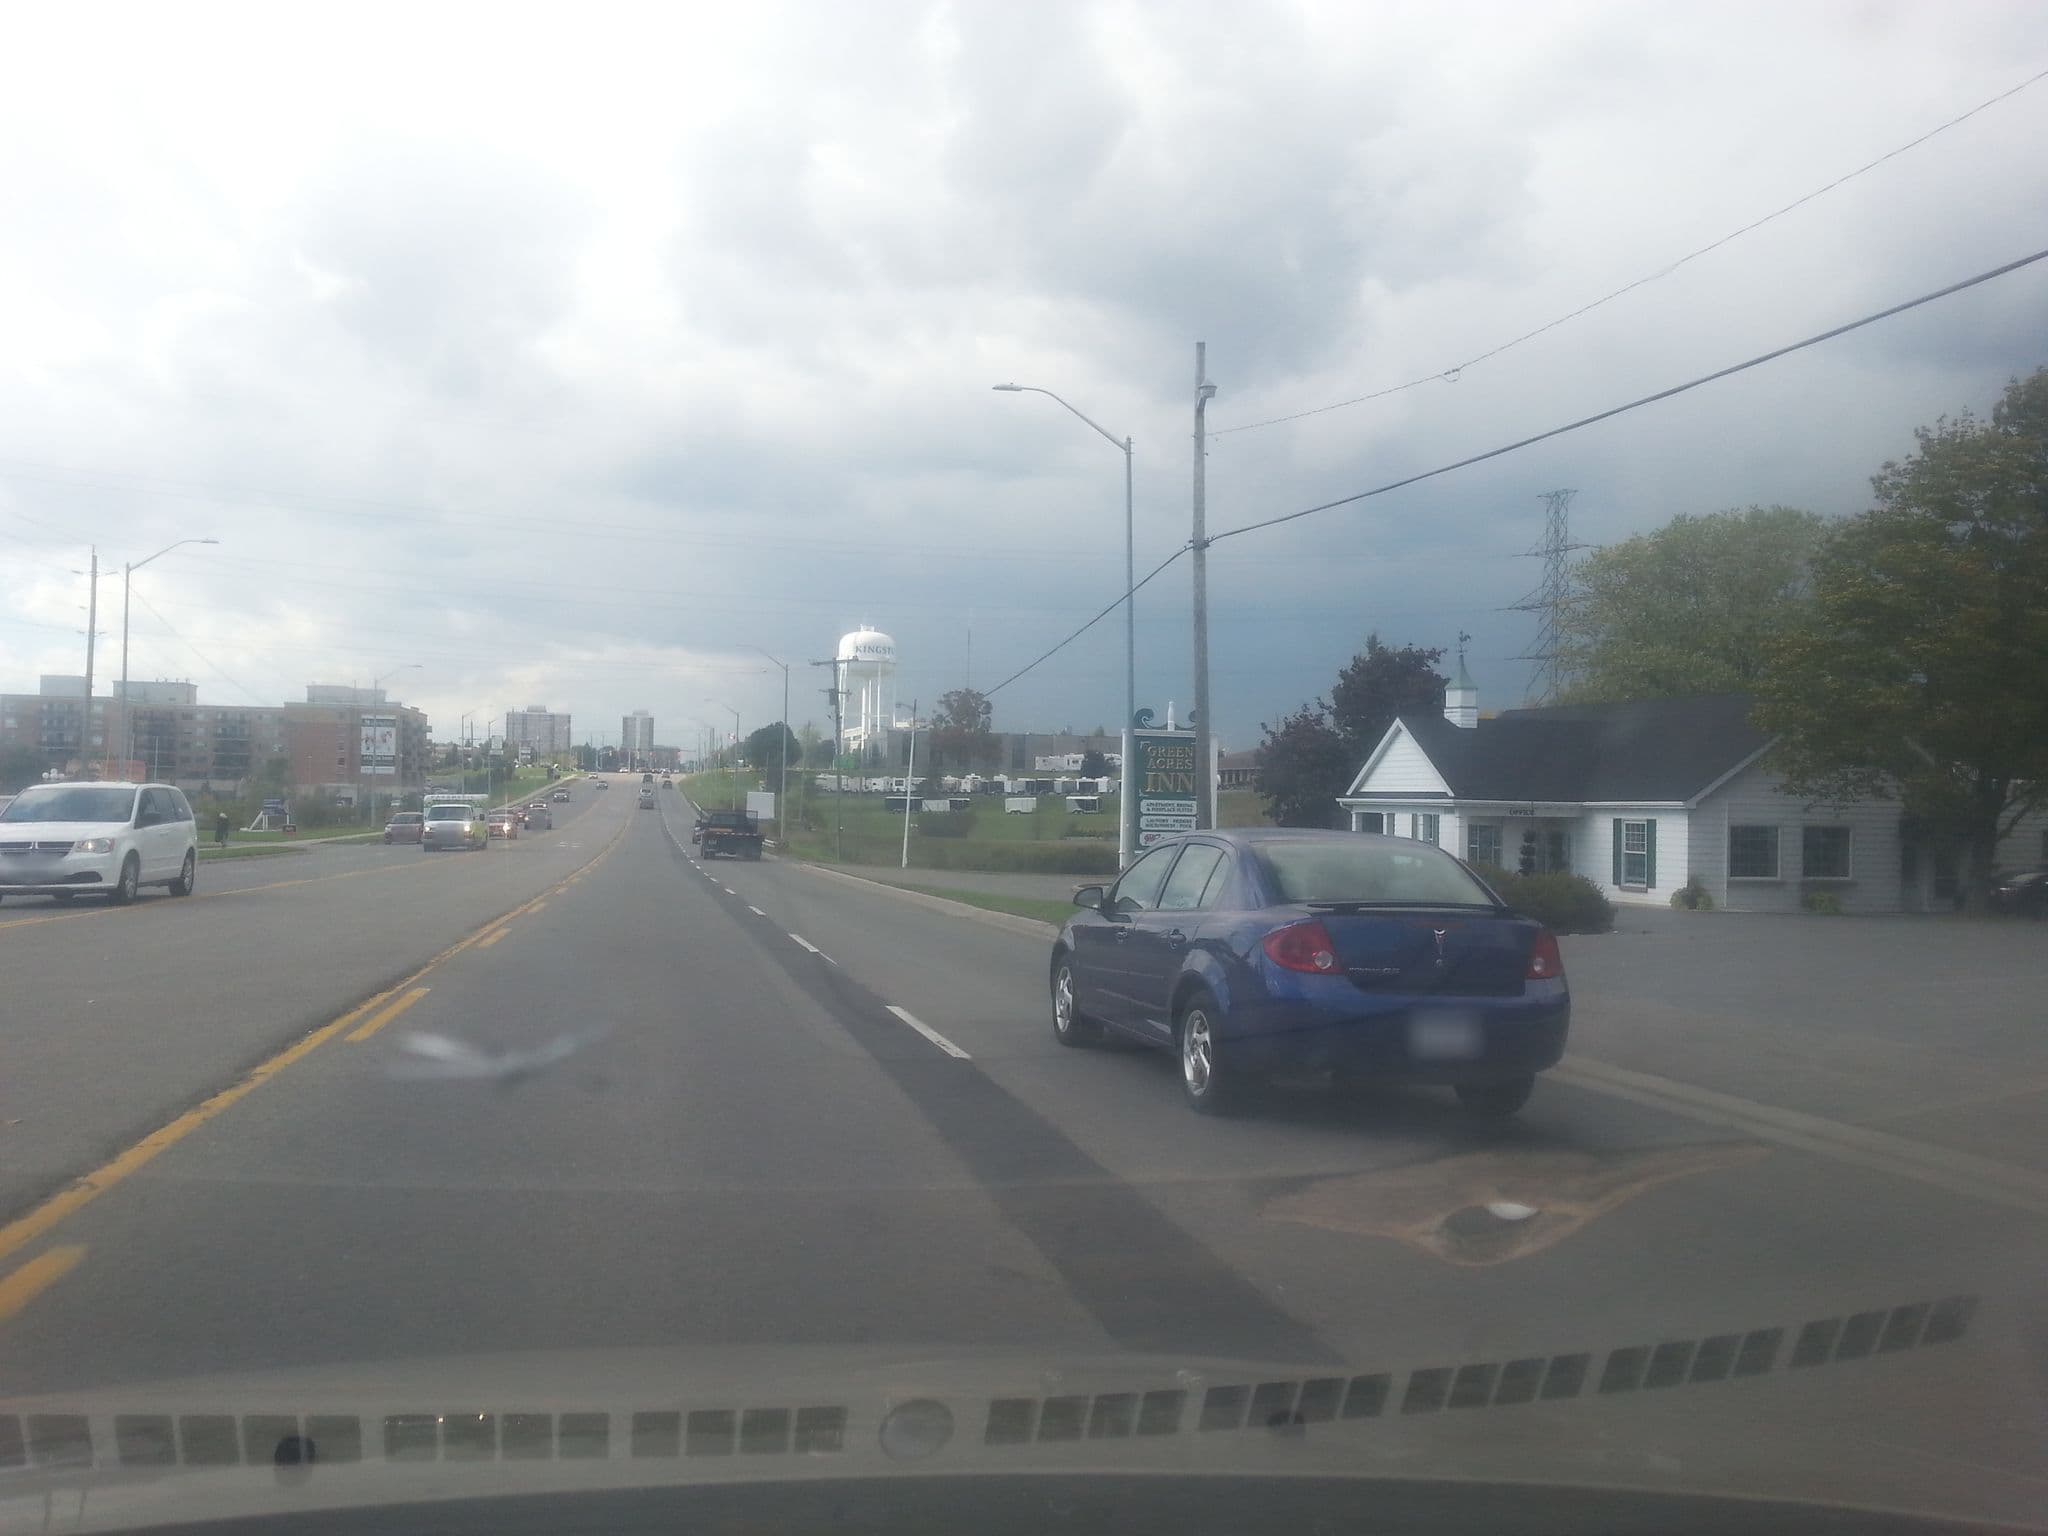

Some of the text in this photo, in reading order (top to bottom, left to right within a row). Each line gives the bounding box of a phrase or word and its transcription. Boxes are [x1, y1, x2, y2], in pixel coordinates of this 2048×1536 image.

[1147, 746, 1193, 757] GREEN
[1146, 758, 1193, 769] ACRES
[1145, 772, 1194, 792] INN
